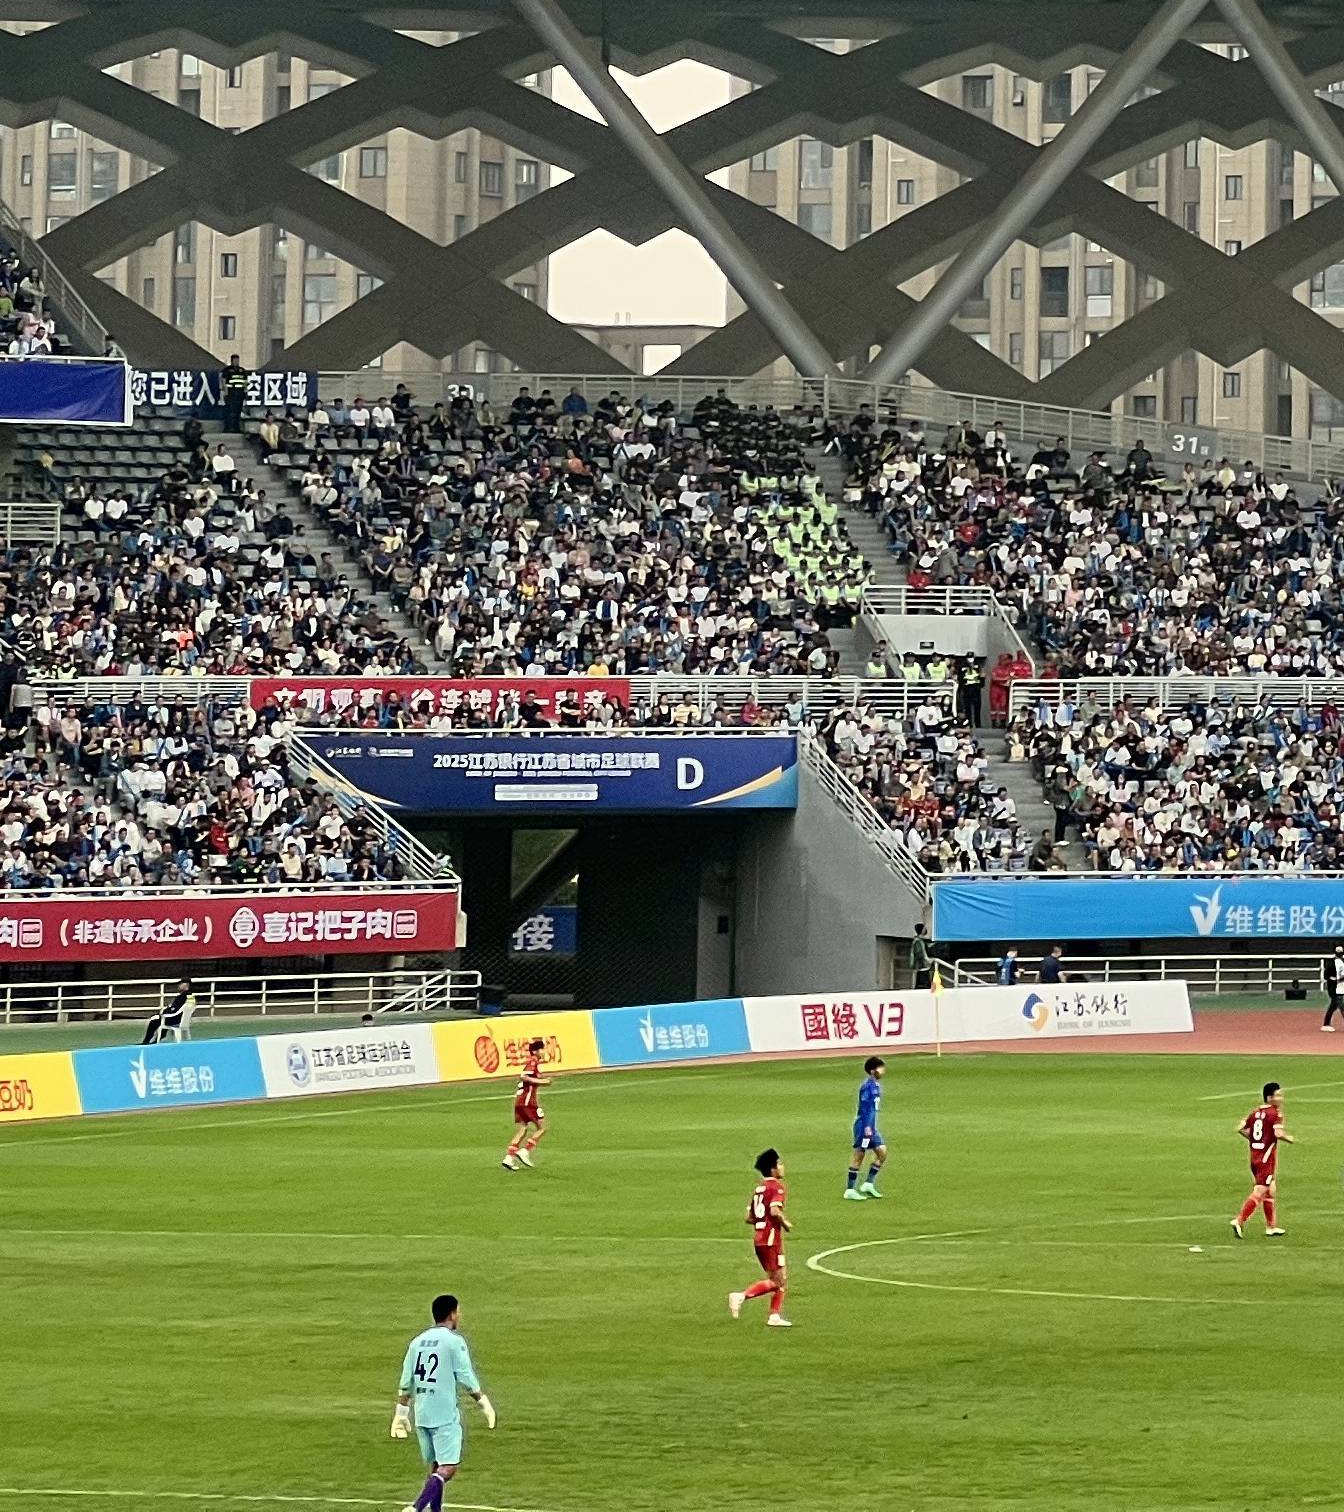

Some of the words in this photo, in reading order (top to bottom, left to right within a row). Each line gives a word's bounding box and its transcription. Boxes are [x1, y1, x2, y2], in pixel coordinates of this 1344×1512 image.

[131, 370, 308, 407] 您已进入控区域
[677, 757, 704, 790] D
[261, 909, 393, 943] 喜记把子肉
[864, 1002, 904, 1038] V3
[1055, 991, 1128, 1017] 江苏银行
[1253, 1119, 1263, 1141] 8
[413, 1351, 438, 1382] 42
